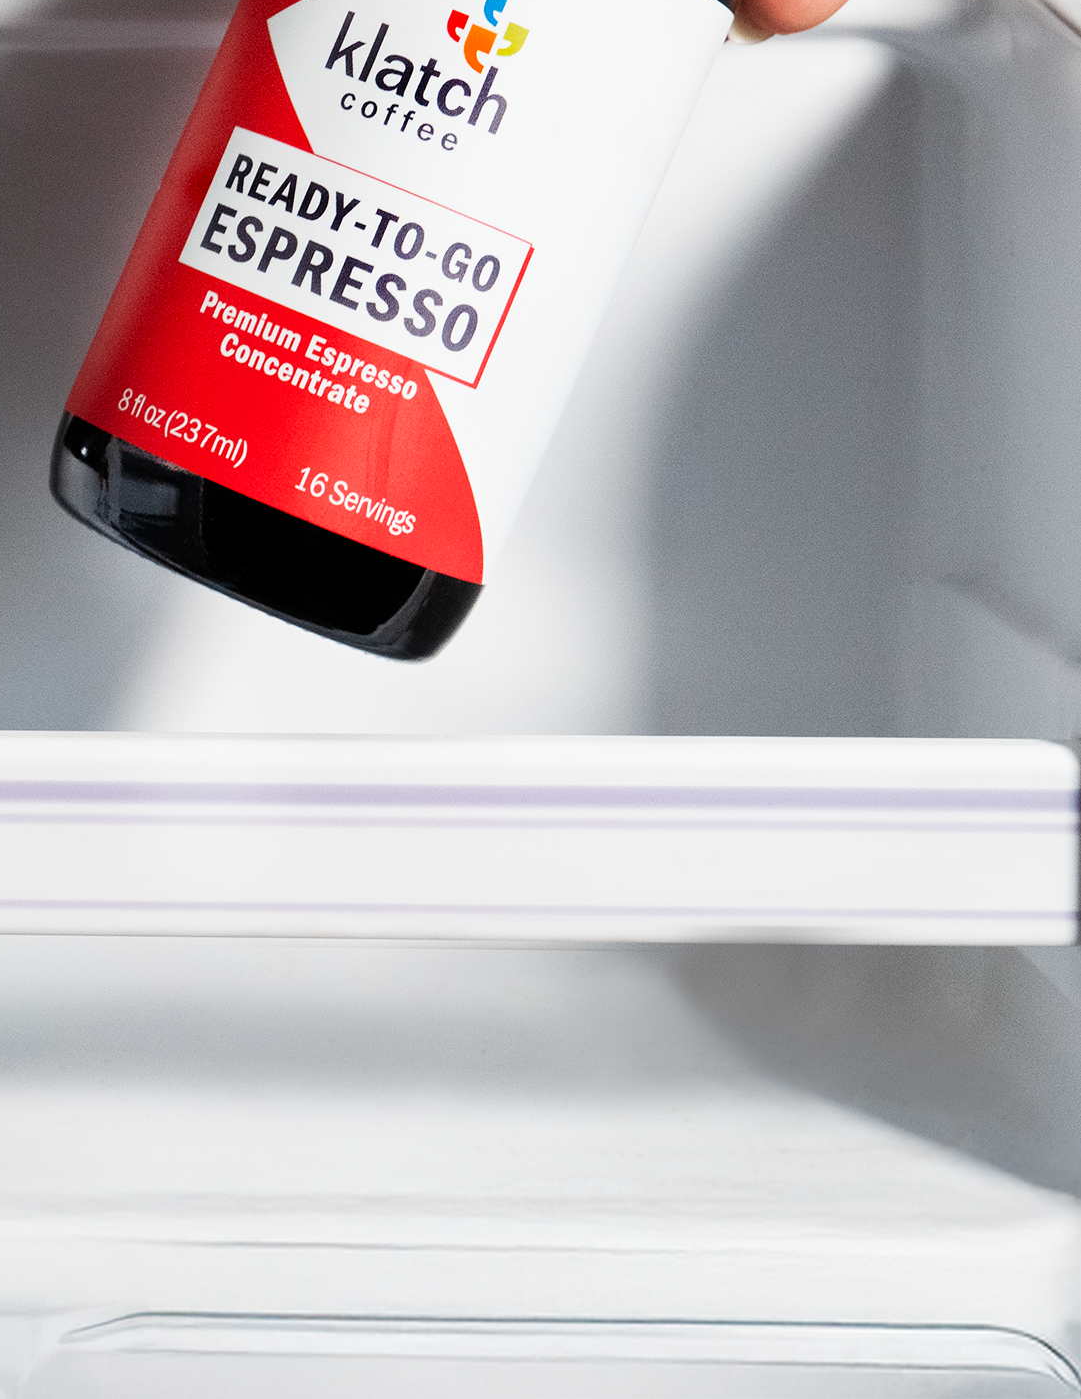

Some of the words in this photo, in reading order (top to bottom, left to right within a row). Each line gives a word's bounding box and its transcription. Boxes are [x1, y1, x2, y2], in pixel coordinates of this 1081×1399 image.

[325, 10, 508, 135] klatch
[340, 92, 460, 152] coffee
[224, 153, 502, 292] READY-TO-GO
[199, 202, 479, 352] ESPRESSO
[199, 290, 302, 353] Premium
[304, 334, 418, 401] Espresso
[220, 332, 371, 414] Concentrate
[118, 388, 133, 411] 8
[131, 393, 147, 418] fl
[144, 405, 167, 429] oz
[164, 409, 248, 469] (237ml)
[294, 466, 330, 498] 16
[328, 479, 417, 537] Servings
